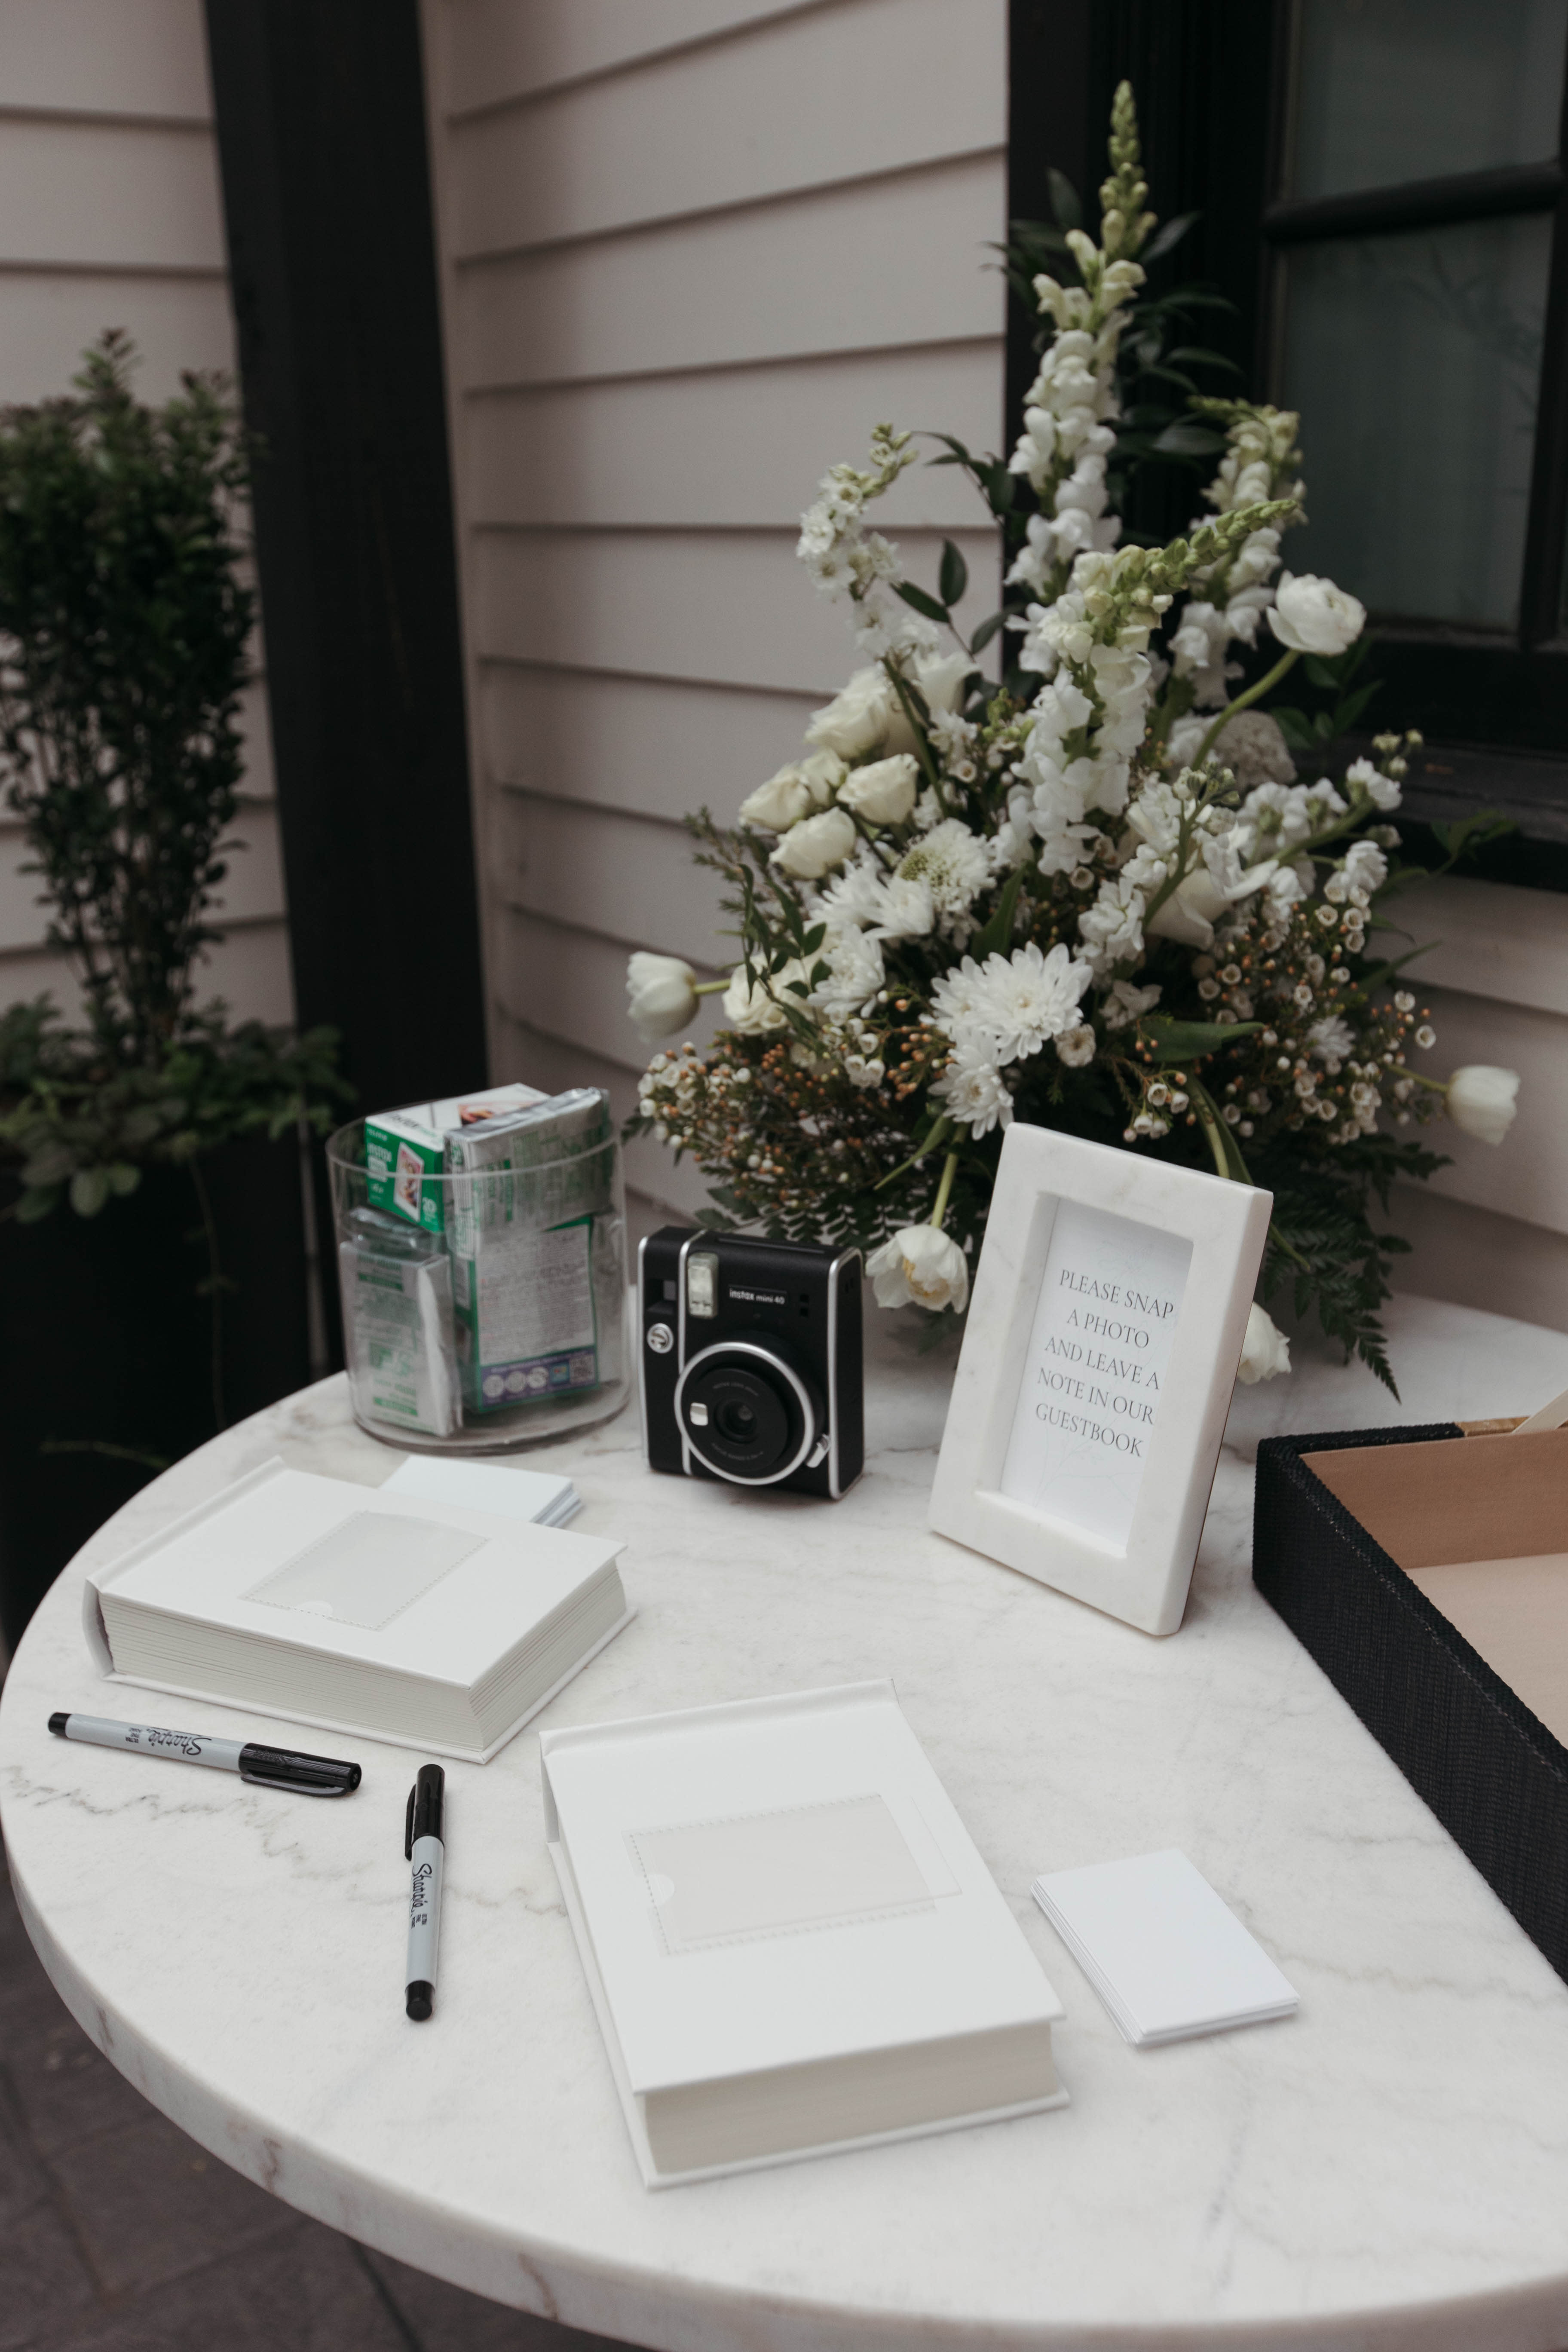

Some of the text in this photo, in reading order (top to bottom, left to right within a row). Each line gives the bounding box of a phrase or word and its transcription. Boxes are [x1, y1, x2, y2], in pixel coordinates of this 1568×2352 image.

[729, 1288, 785, 1305] instax mini 40
[1060, 1269, 1174, 1319] PLEASE SNAP
[1067, 1310, 1149, 1348] A PHOTO
[1045, 1338, 1160, 1390] AND LEAVE A
[1037, 1368, 1155, 1424] NOTE IN OUR
[1036, 1403, 1142, 1458] GUESTBOOK
